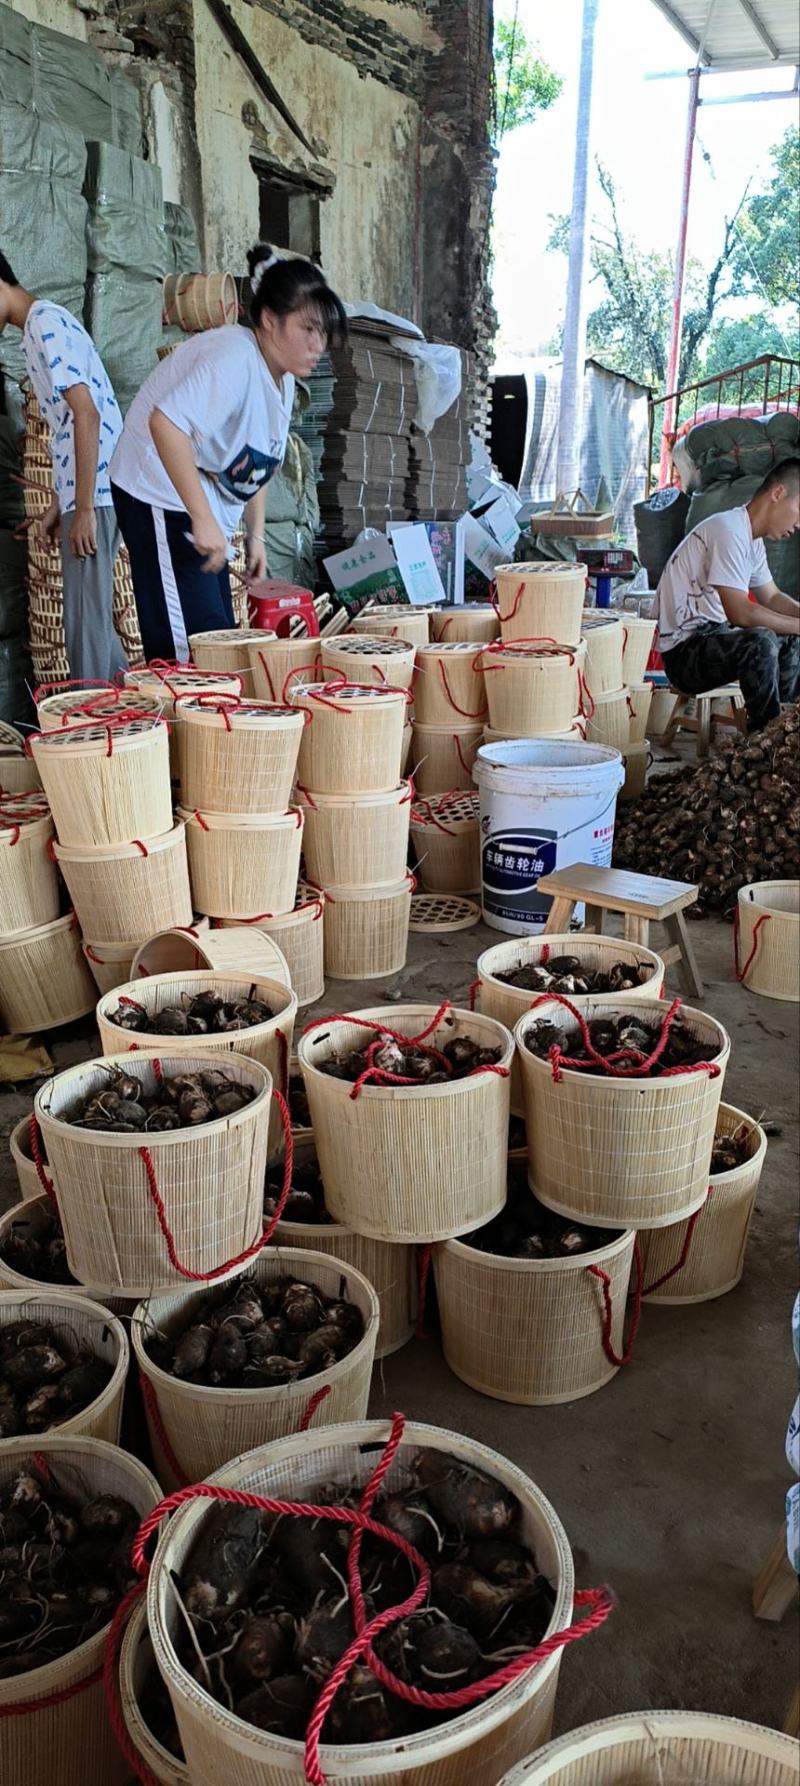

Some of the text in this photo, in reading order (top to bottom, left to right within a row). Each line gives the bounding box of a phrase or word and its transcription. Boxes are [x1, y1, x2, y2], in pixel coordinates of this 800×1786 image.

[485, 850, 545, 872] 车辆齿轮油
